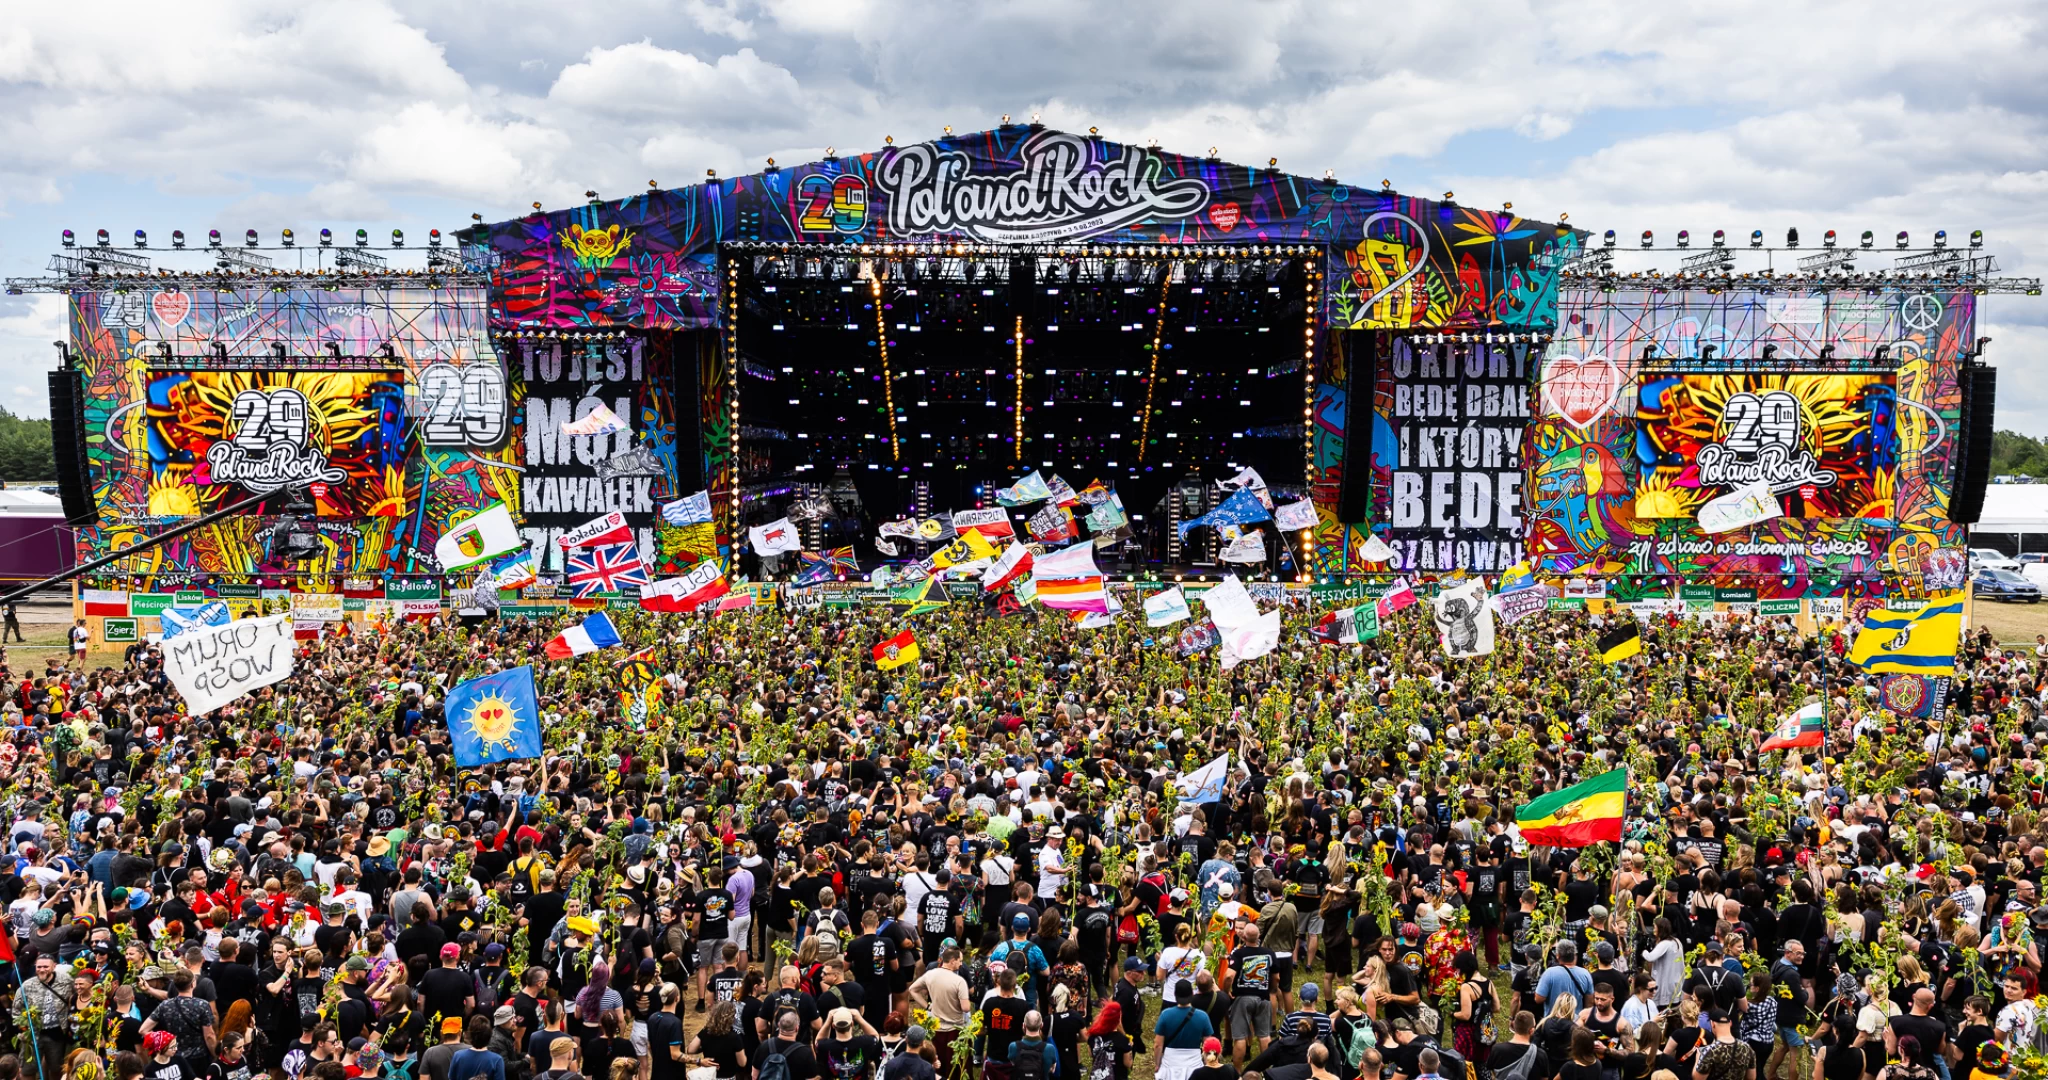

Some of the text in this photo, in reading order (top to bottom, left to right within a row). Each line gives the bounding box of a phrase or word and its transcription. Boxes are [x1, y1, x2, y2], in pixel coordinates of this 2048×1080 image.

[1395, 384, 1531, 422] BĘDĘ DBAŁ
[524, 477, 653, 513] KAWAŁEK
[1393, 472, 1522, 538] BĘDĘ
[317, 522, 361, 538] muzyka
[134, 600, 173, 610] Pieścirogi
[177, 593, 203, 601] Lisków
[107, 625, 135, 635] Zgierz
